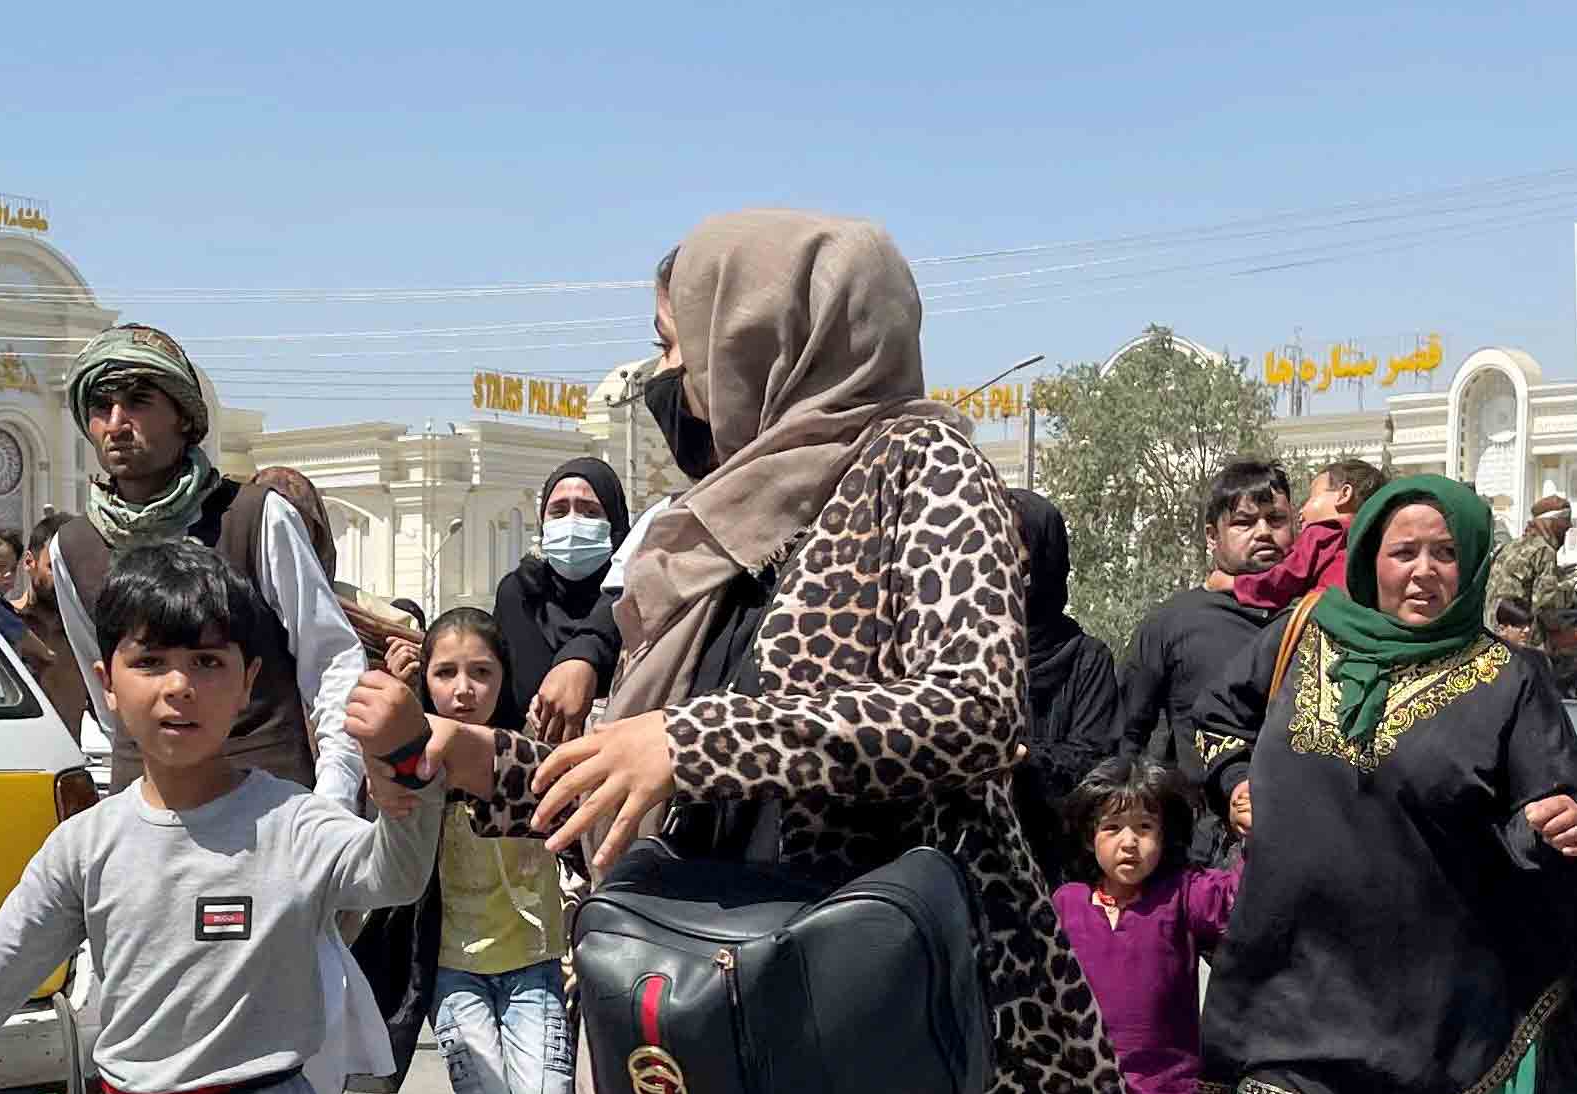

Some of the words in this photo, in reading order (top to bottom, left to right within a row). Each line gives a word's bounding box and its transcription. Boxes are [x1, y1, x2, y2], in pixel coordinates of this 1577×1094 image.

[1380, 332, 1443, 387] قصر
[473, 372, 523, 413] STARS
[528, 379, 587, 419] PALACE
